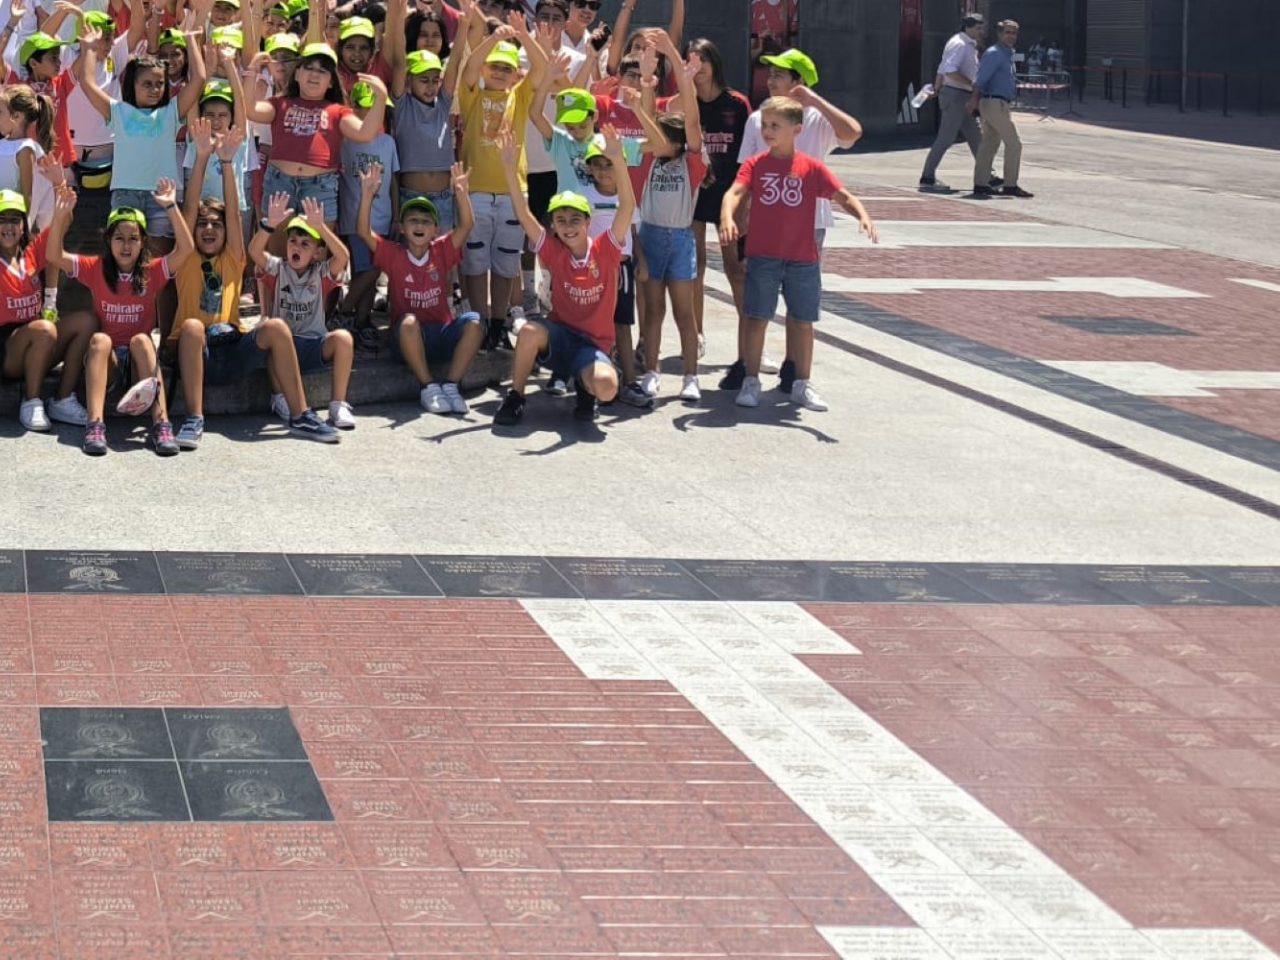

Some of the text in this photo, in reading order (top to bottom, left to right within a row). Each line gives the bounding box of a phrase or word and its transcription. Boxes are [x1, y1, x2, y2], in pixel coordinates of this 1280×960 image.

[760, 173, 803, 207] 38
[404, 287, 441, 300] Emirates
[563, 281, 604, 298] Emirates
[101, 300, 145, 313] Emirates
